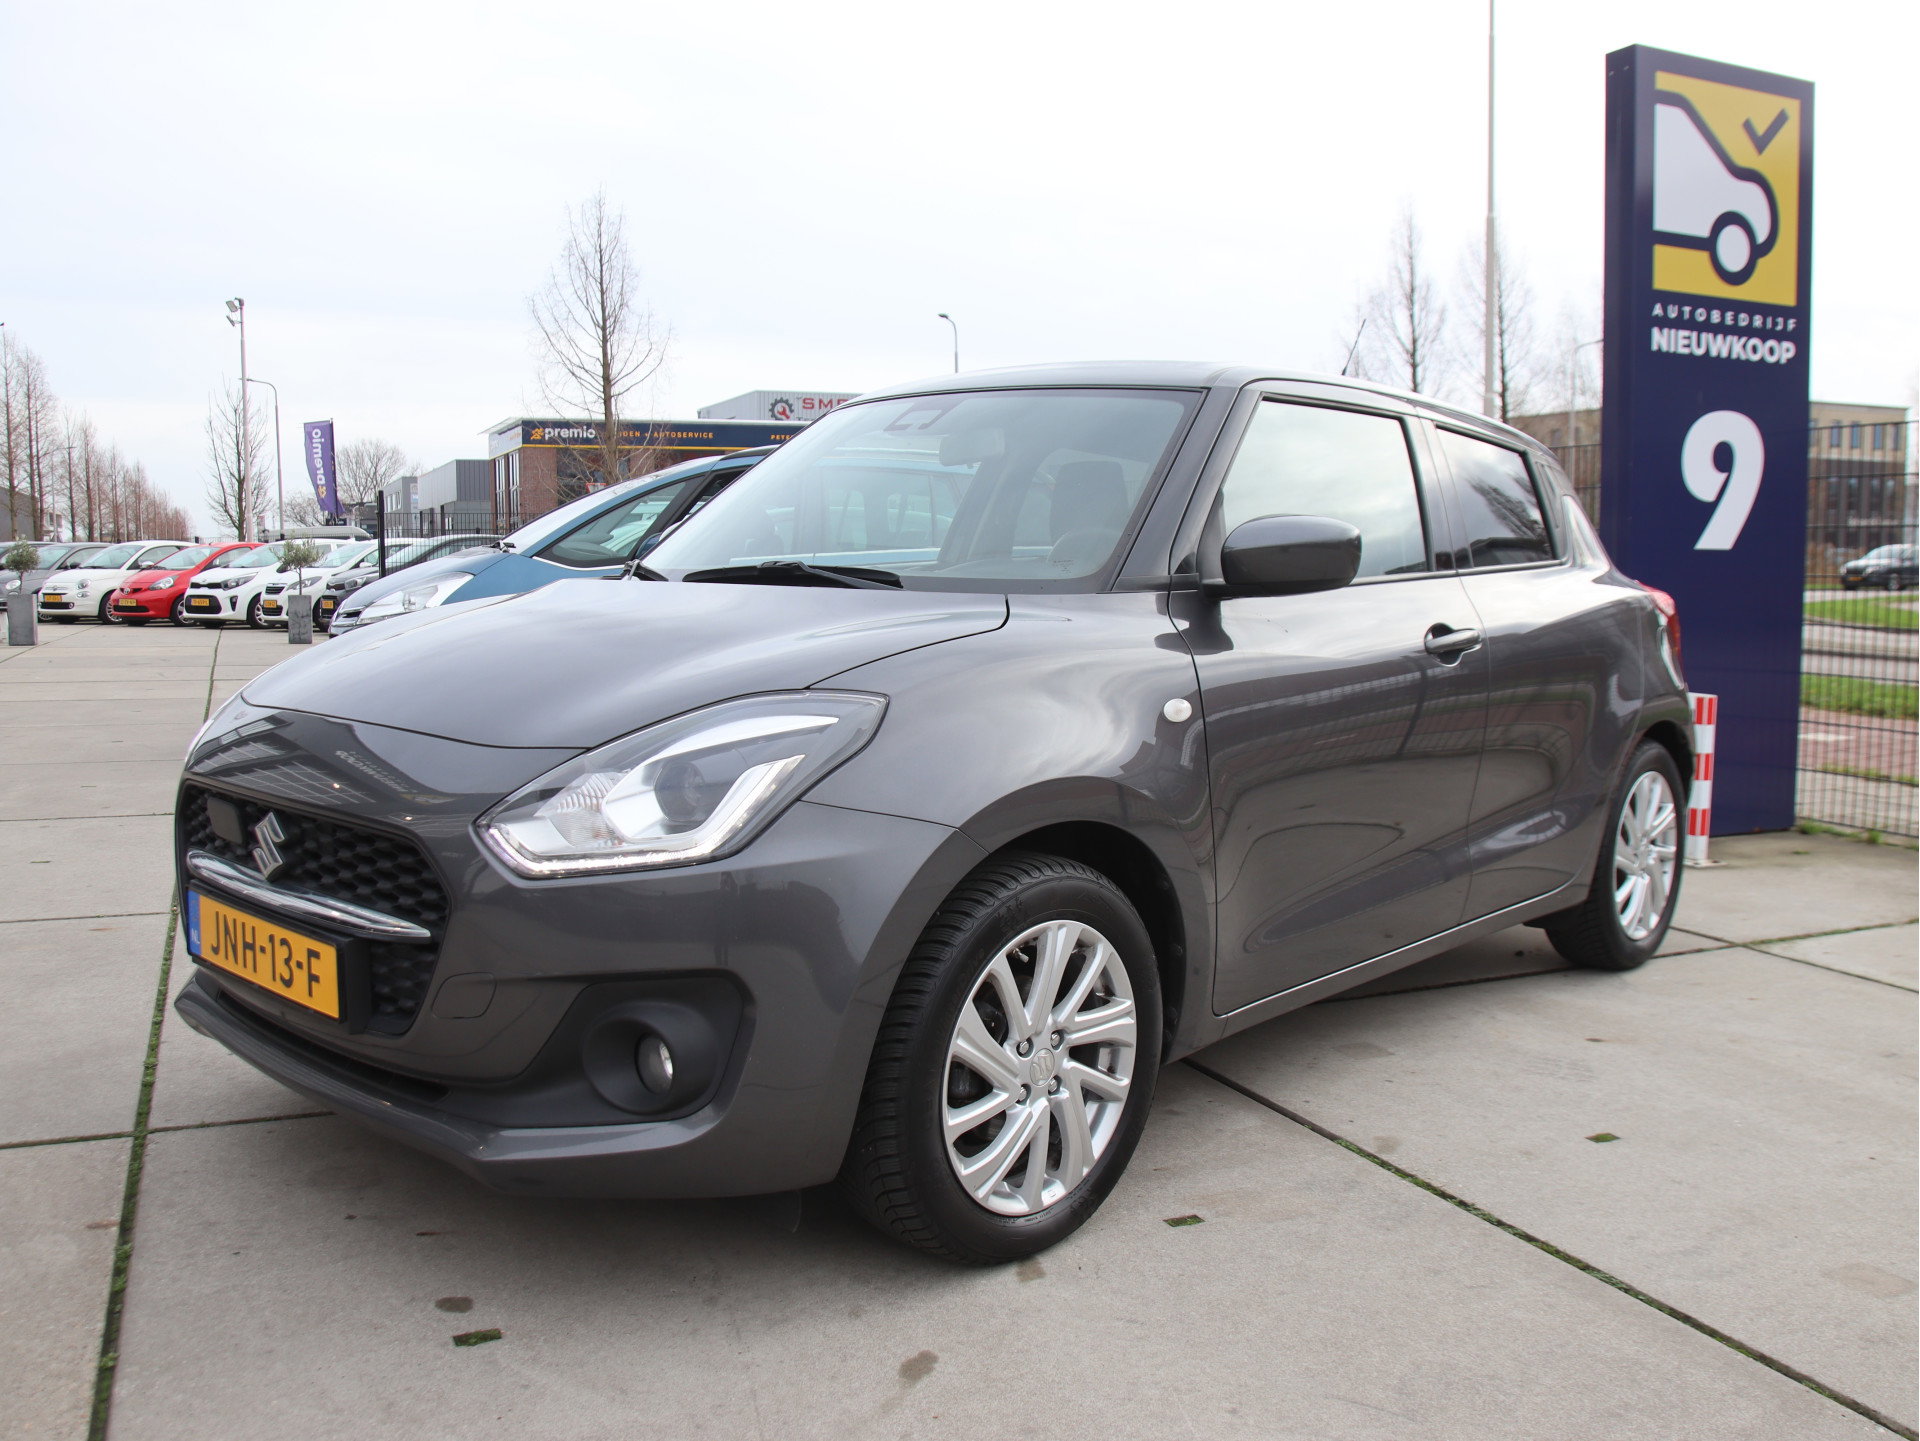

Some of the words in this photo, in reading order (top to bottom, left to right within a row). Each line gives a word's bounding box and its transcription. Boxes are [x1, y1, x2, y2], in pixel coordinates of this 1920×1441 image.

[1652, 302, 1797, 332] AUTOBEDRIJF
[1651, 327, 1797, 364] NIEUWKOOP
[545, 425, 596, 440] premio
[653, 431, 714, 439] AUTOSERVICE
[1681, 410, 1765, 551] 9
[191, 927, 200, 944] NL
[211, 910, 321, 998] JNH-13-F
